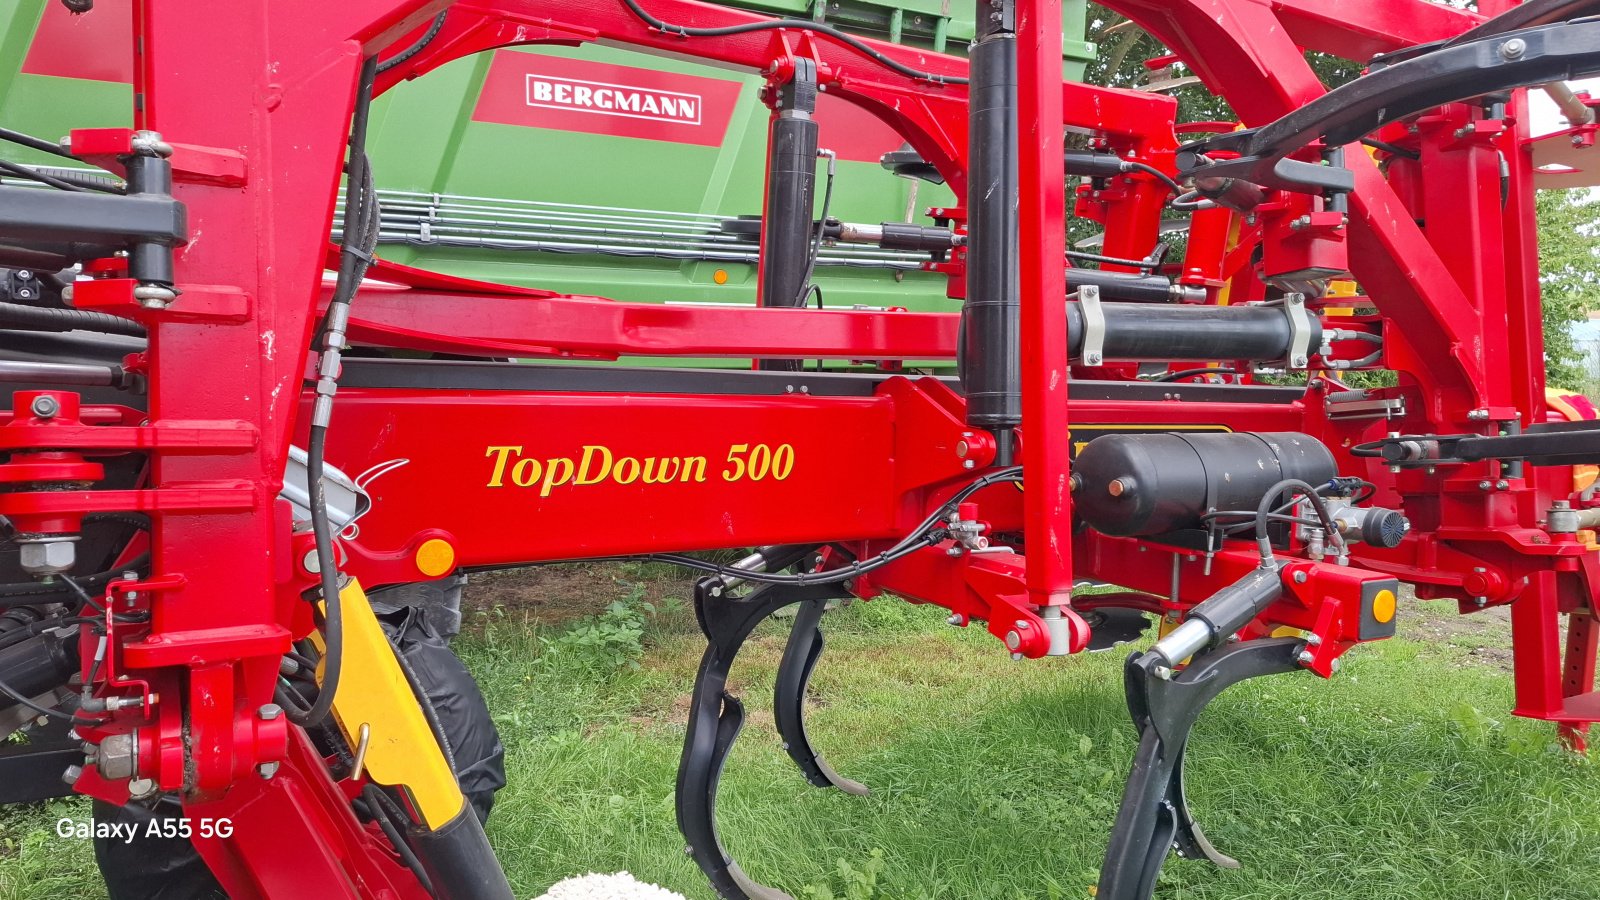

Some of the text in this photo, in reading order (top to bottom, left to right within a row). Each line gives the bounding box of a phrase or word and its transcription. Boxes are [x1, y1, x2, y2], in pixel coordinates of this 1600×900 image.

[533, 81, 695, 119] BERGMANN
[485, 443, 795, 497] TopDown 500
